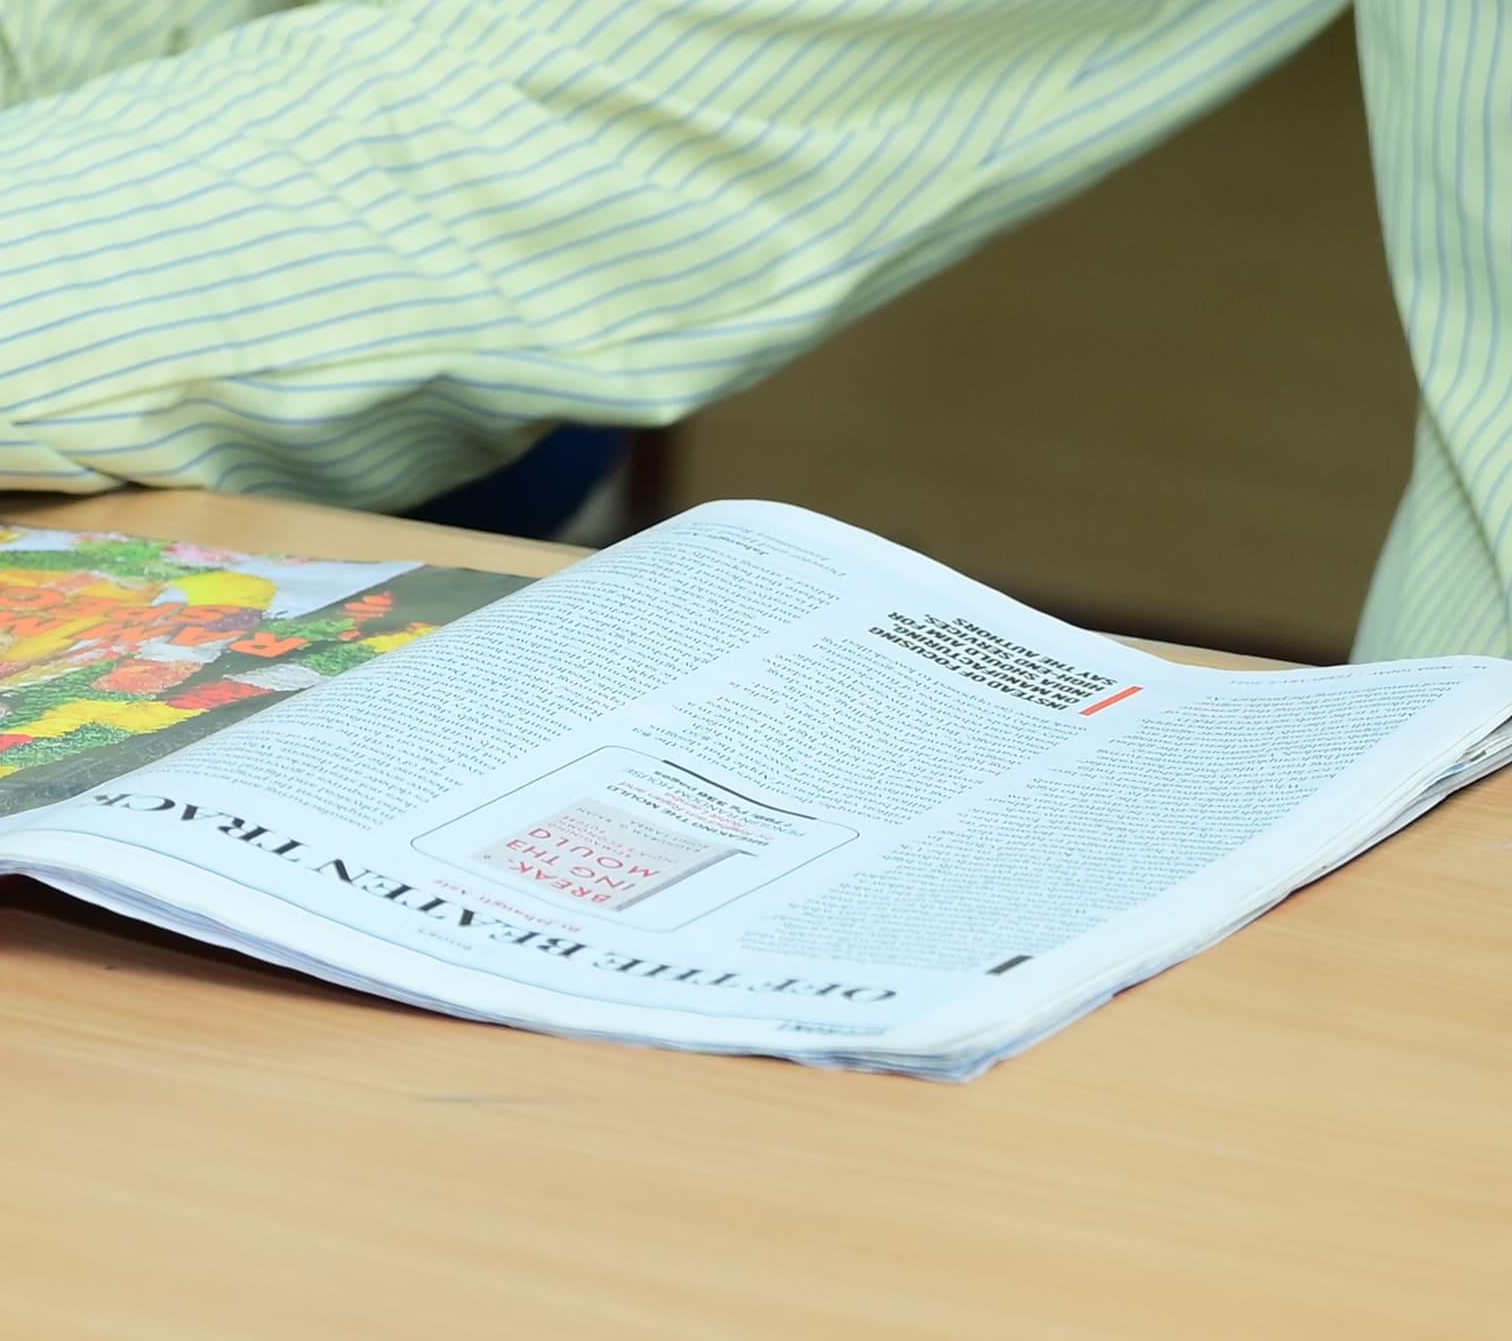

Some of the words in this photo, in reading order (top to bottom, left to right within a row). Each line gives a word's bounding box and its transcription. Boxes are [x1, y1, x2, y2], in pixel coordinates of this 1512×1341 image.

[886, 610, 926, 630] FOR
[67, 620, 308, 657] RAM
[866, 625, 958, 670] FOCUSING
[926, 629, 964, 648] AIM
[952, 616, 1038, 657] AUTHORS
[891, 622, 1047, 694] MANUFACTURING,
[963, 647, 1036, 679] SHOULD
[1037, 655, 1074, 672] THE
[958, 669, 985, 682] OF
[1012, 656, 1104, 691] HIGH-END
[1077, 670, 1117, 685] SAY
[986, 679, 1068, 710] INSTEAD
[1039, 677, 1091, 697] INDIA
[1050, 692, 1079, 703] ON
[604, 783, 659, 809] MOULD
[660, 807, 688, 822] THE
[526, 827, 658, 877] MOULD
[567, 865, 635, 890] ING
[309, 857, 594, 959] BEATEN
[590, 950, 743, 989] THE
[745, 977, 896, 1003] OFF
